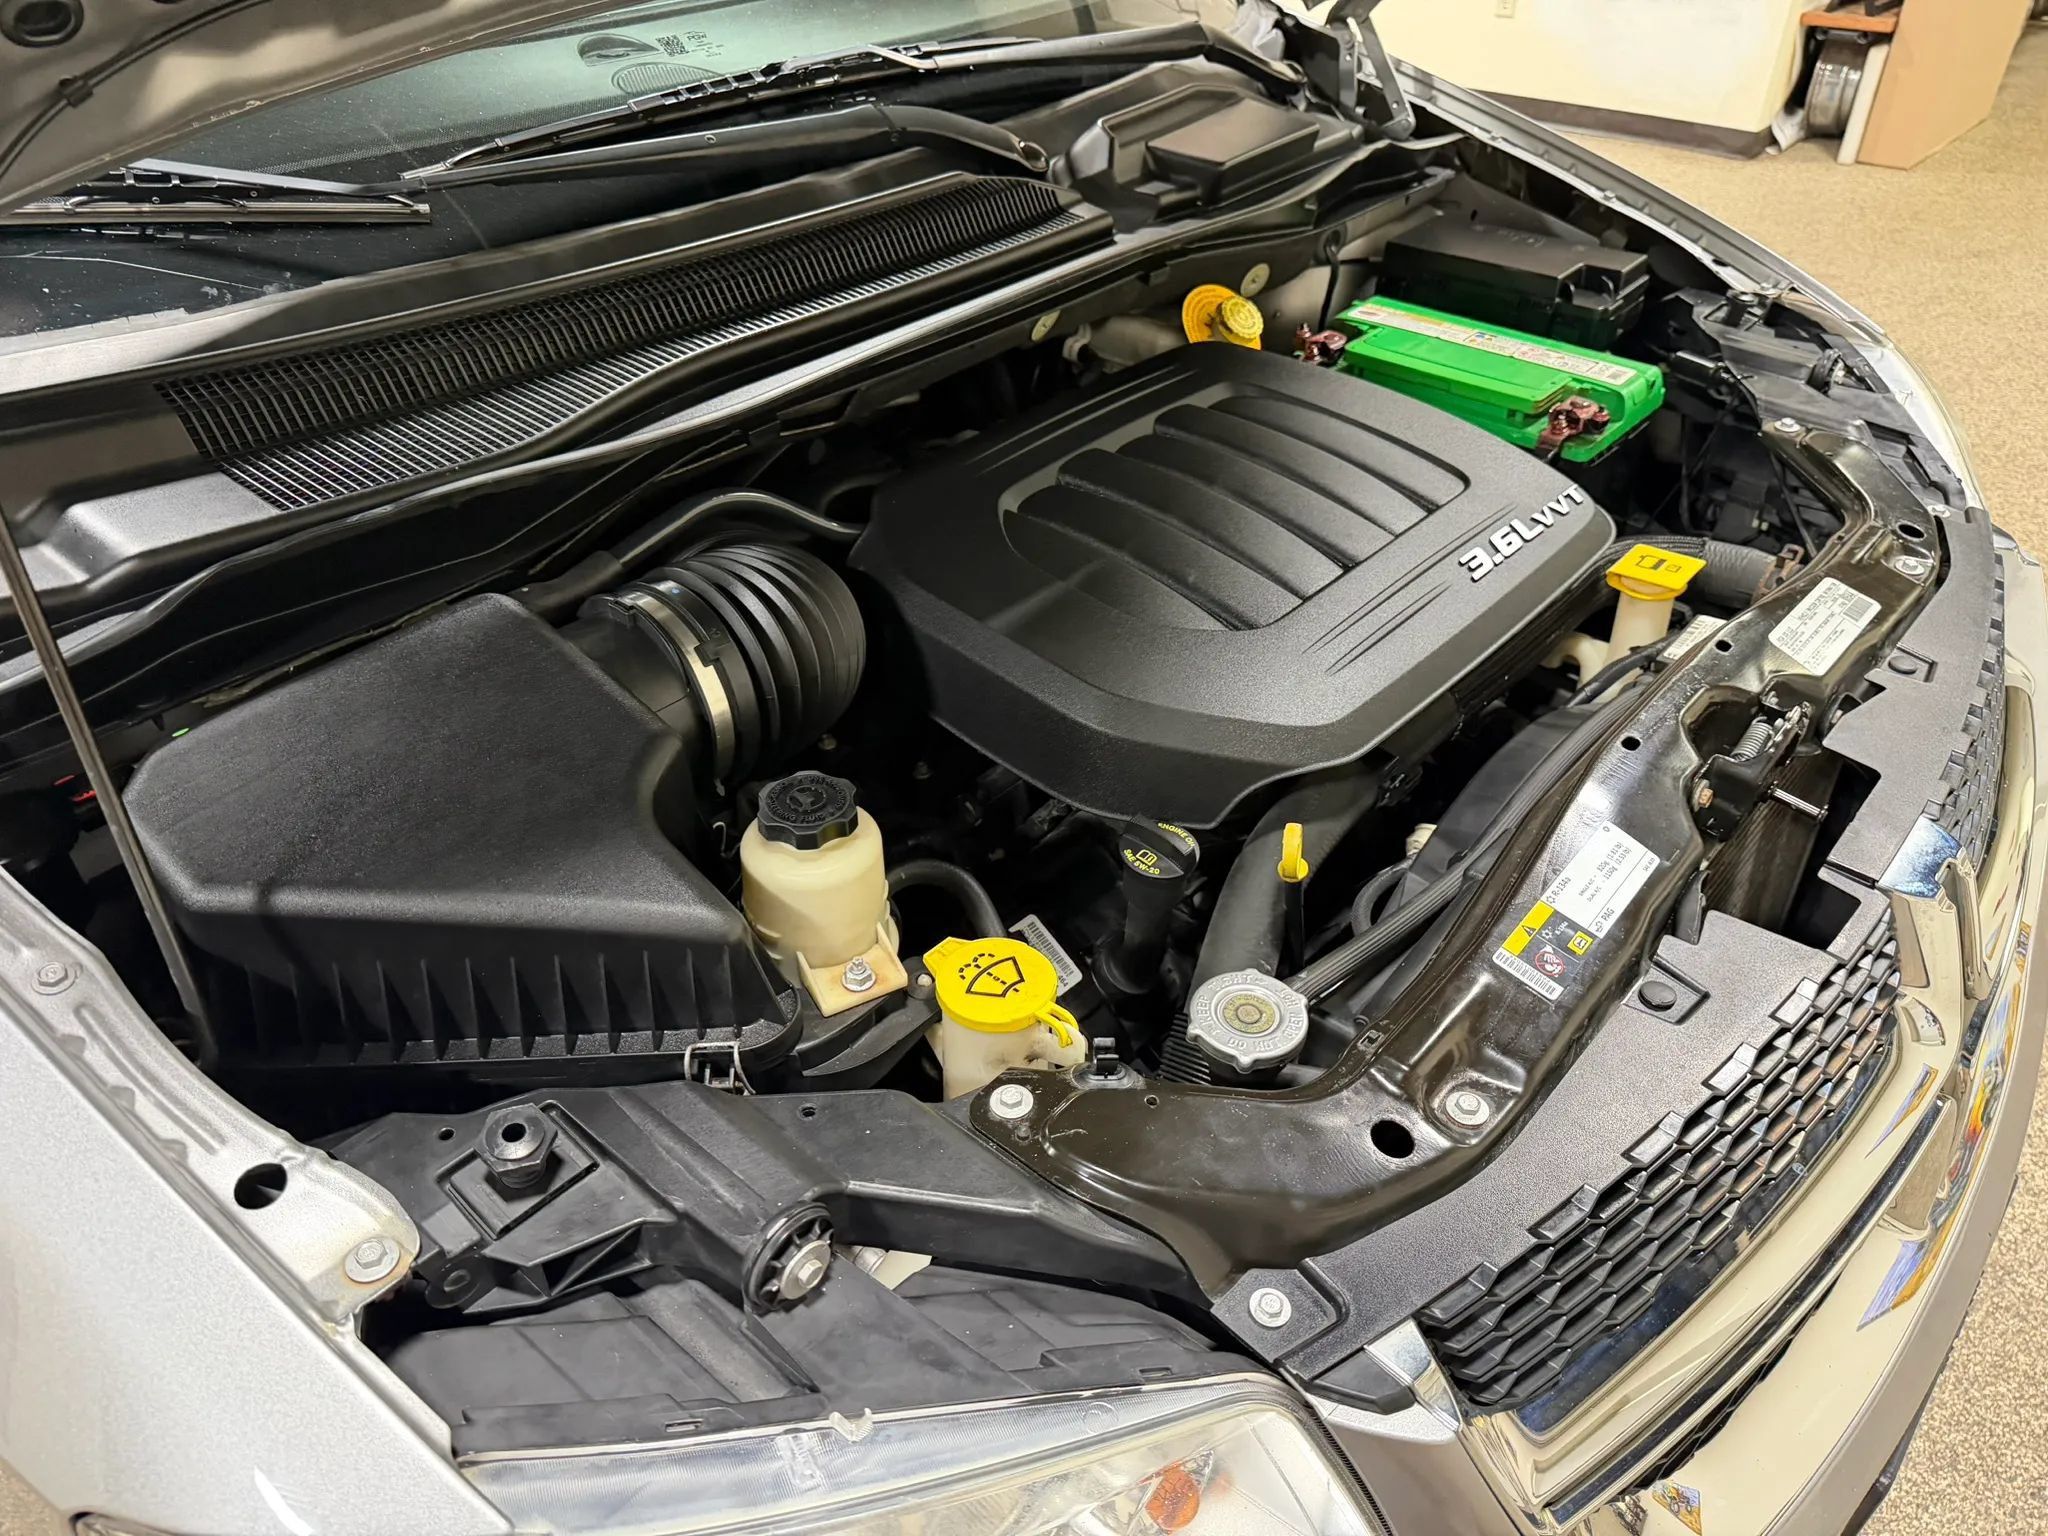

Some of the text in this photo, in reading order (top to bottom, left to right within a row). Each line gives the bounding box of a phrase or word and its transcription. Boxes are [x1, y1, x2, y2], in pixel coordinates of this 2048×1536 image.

[1158, 822, 1186, 838] ENGINE
[1124, 849, 1160, 875] SAE 5W-20
[1600, 907, 1615, 921] PAG
